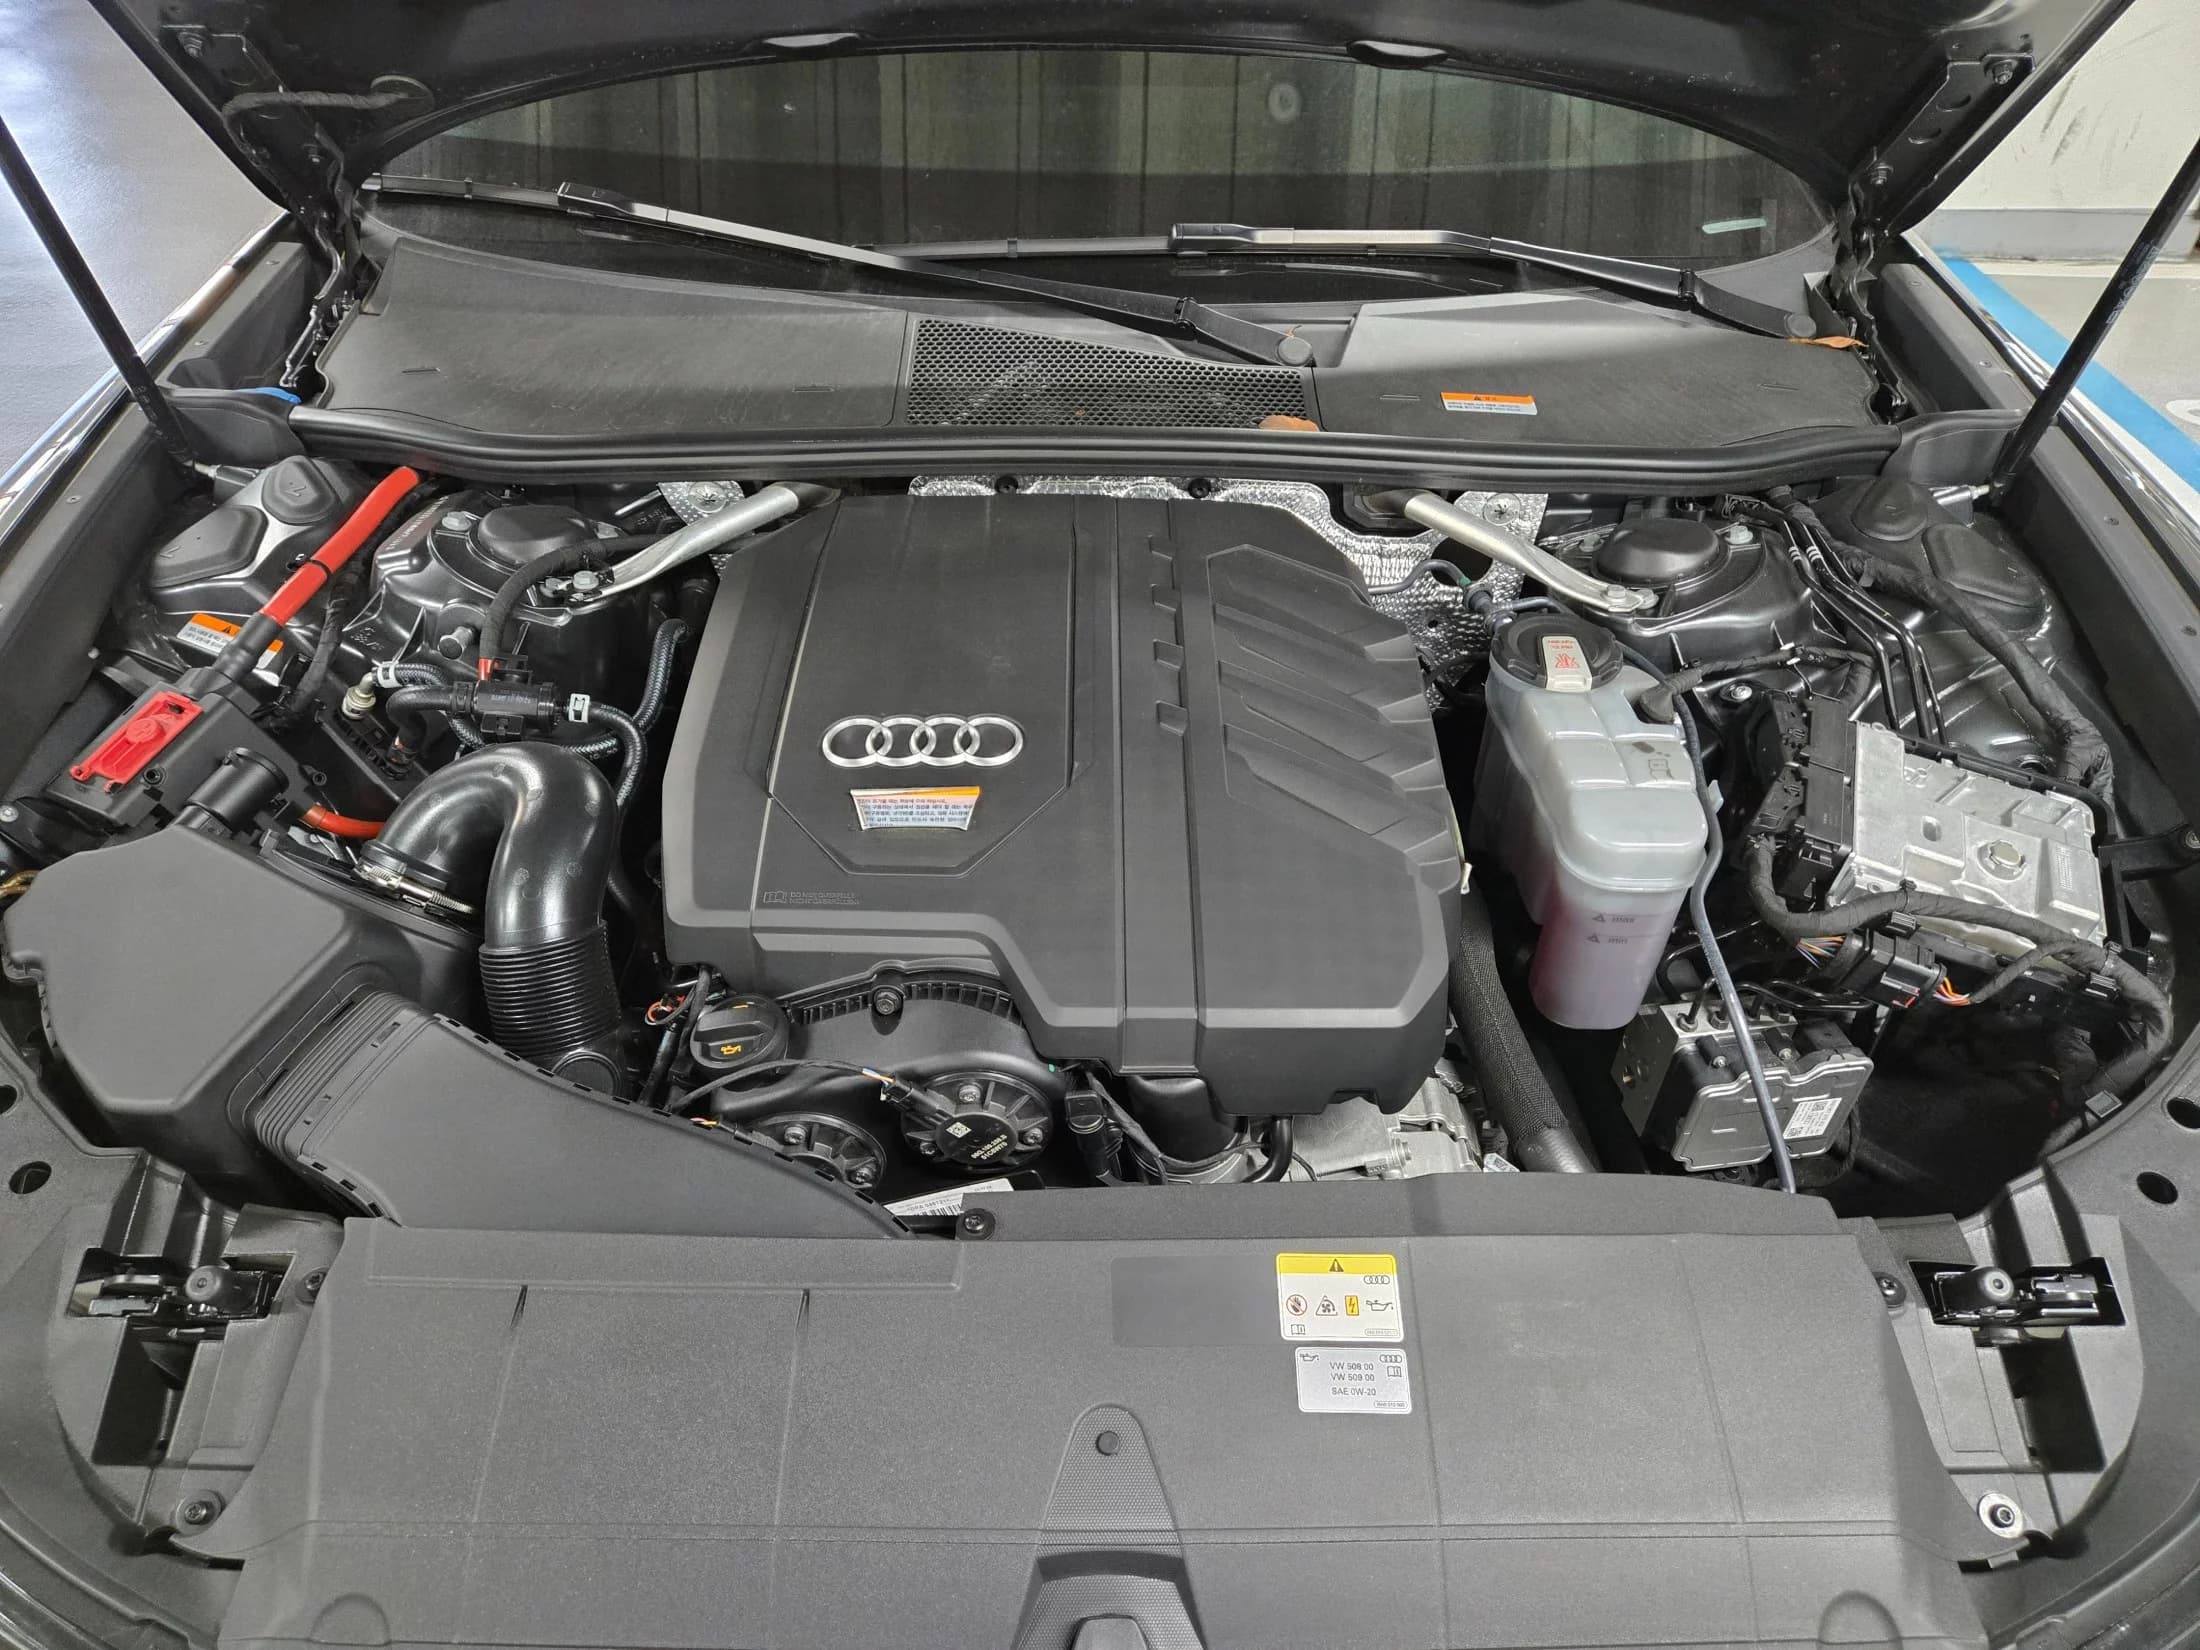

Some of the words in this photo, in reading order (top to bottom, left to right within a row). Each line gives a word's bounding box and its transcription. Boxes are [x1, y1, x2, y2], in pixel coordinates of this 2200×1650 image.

[1329, 1361, 1345, 1370] VW
[1347, 1362, 1362, 1371] 508
[1363, 1362, 1374, 1371] 00
[1330, 1372, 1346, 1381] VW
[1347, 1373, 1363, 1381] 509
[1364, 1373, 1375, 1382] 00
[1331, 1387, 1349, 1396] SAE
[1350, 1387, 1377, 1396] 0W-20
